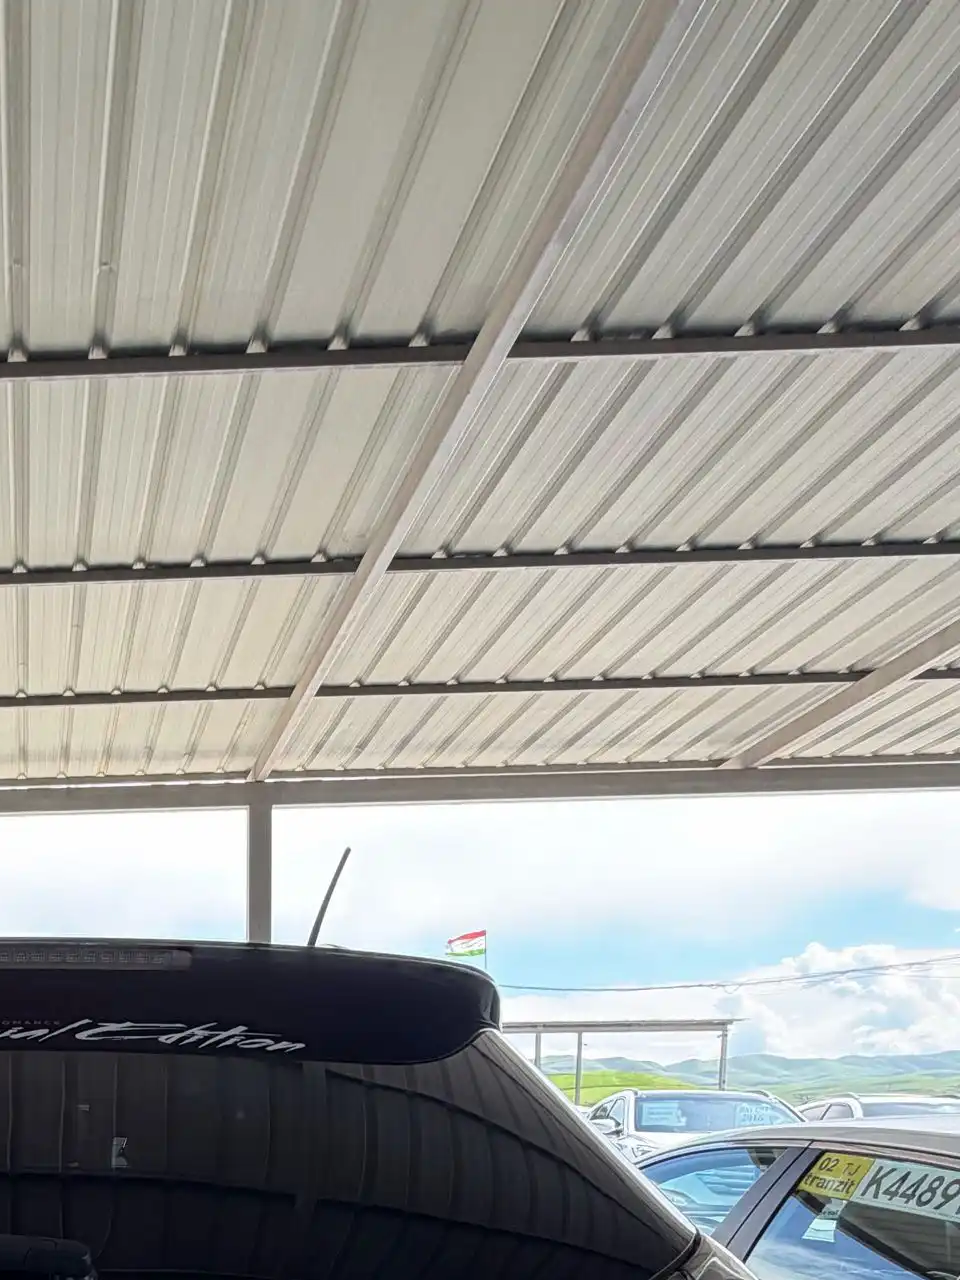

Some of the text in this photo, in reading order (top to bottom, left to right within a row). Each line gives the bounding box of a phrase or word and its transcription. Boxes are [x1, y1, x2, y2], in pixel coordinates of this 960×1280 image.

[74, 1021, 306, 1054] Edition
[817, 1157, 863, 1177] 02 TJ
[803, 1172, 856, 1195] tranzit
[860, 1165, 960, 1215] K4489
